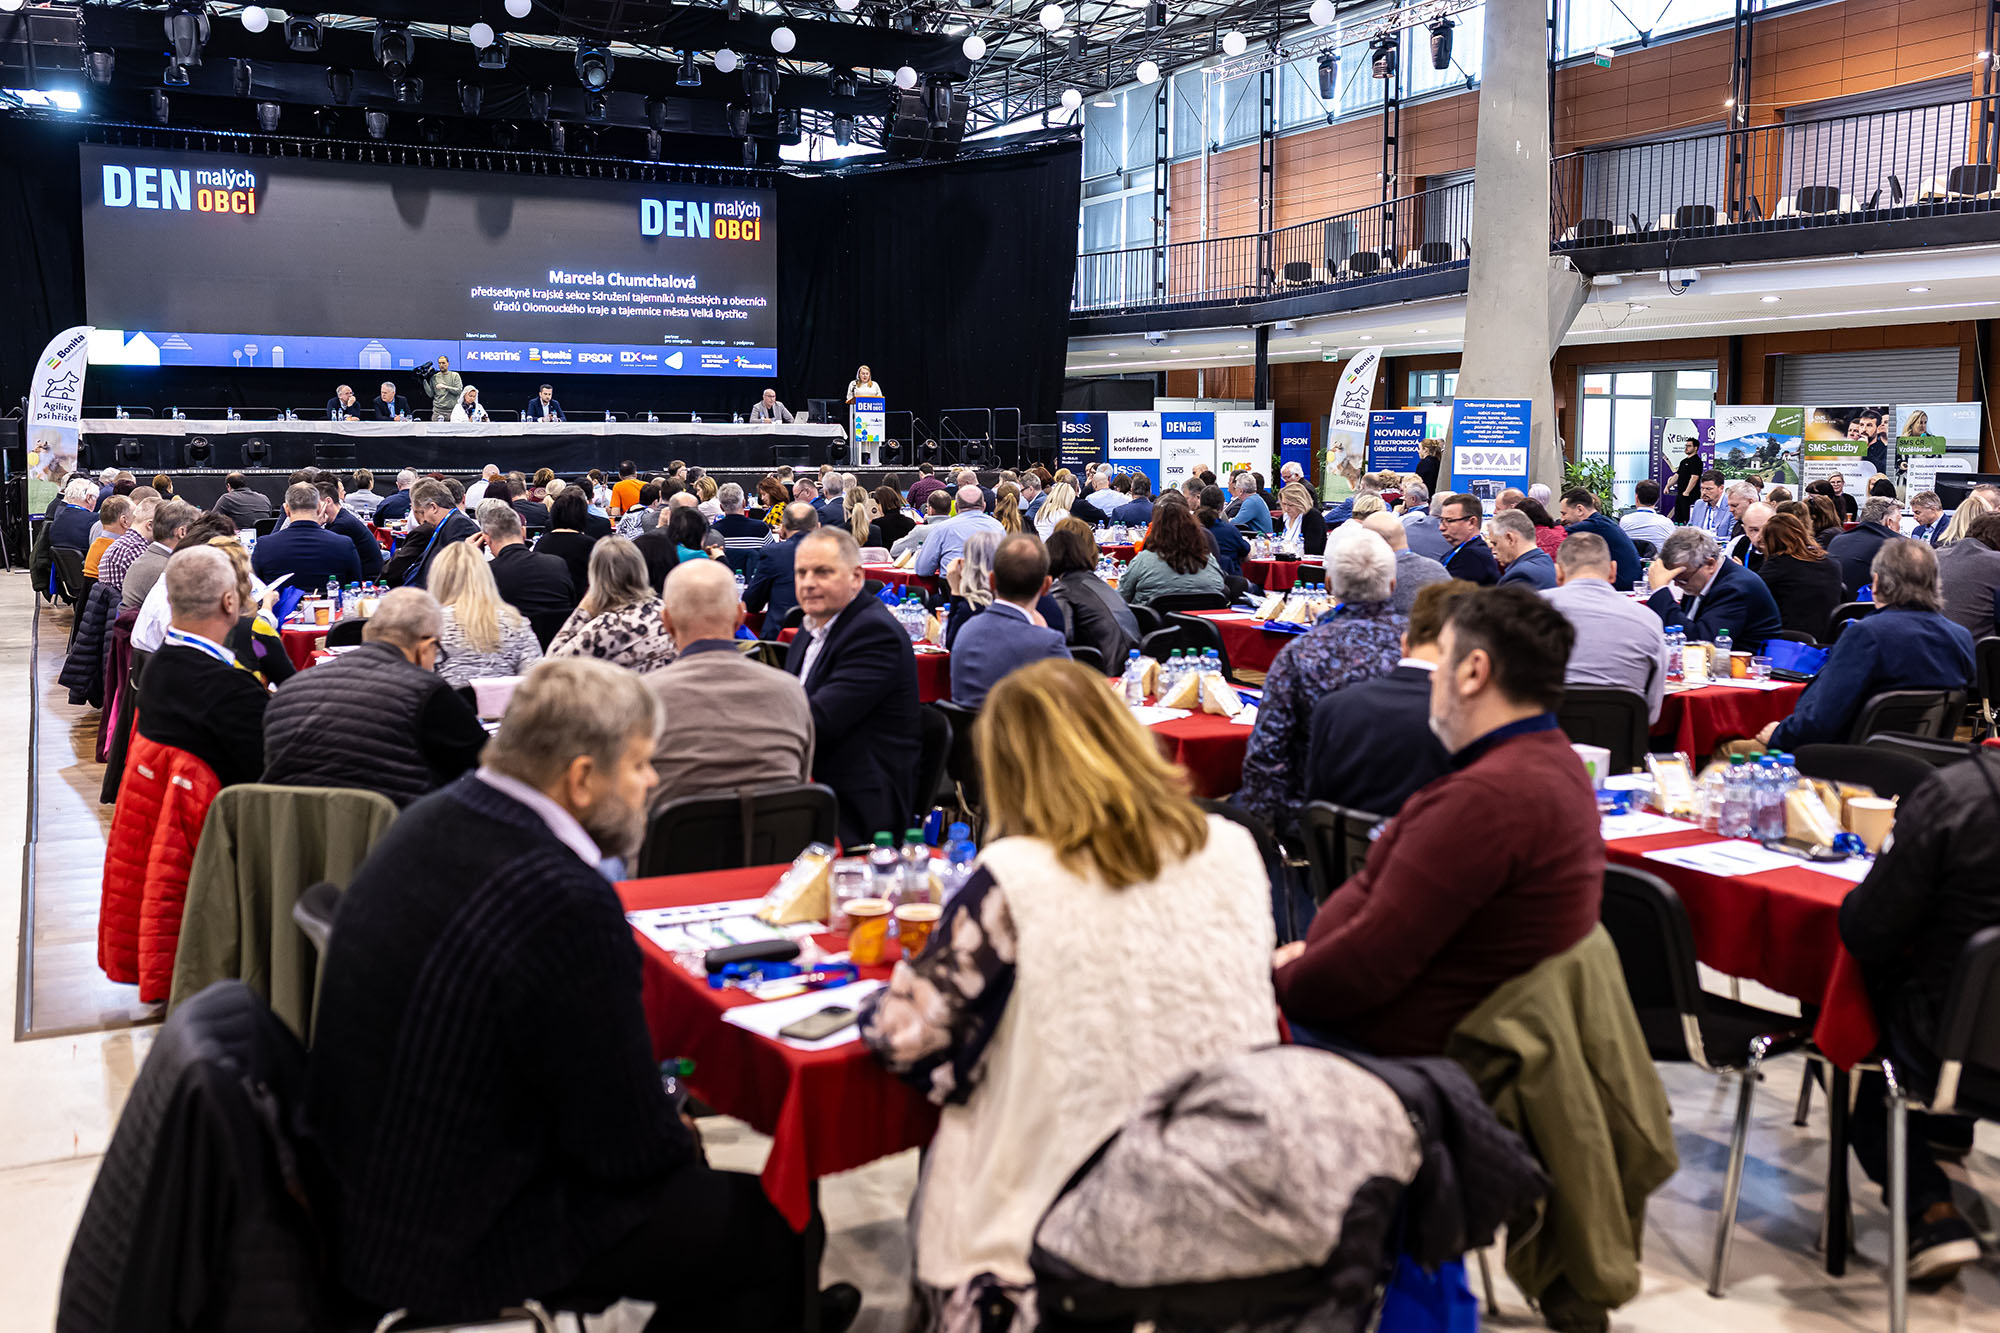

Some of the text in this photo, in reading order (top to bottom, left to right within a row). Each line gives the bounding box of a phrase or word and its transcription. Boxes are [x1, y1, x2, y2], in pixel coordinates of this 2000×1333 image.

[102, 165, 191, 210] DEN
[196, 168, 256, 190] malých
[197, 188, 256, 214] OBCÍ
[714, 200, 760, 219] malých
[640, 198, 710, 239] DEN
[714, 218, 761, 241] OBCÍ
[549, 270, 696, 288] Marcela Chumchalová
[471, 286, 530, 299] předsedkyně
[532, 289, 563, 300] krajské
[566, 292, 590, 300] sekce
[593, 292, 630, 302] Sdružení
[632, 293, 675, 304] tajemníků
[677, 295, 720, 306] městských
[730, 296, 767, 306] obecních
[493, 301, 520, 311] úřadů
[522, 303, 585, 314] Olomouckého
[587, 305, 608, 316] kraje
[619, 306, 661, 317] tajemnice
[663, 308, 689, 317] města
[691, 308, 713, 318] Velká
[715, 309, 748, 320] Bystřice
[57, 334, 85, 359] Bonita
[467, 352, 478, 360] AC
[578, 353, 611, 363] EPSON
[1354, 354, 1375, 374] Bonita
[43, 402, 73, 413] Agility
[1341, 410, 1363, 420] Agility
[37, 412, 78, 423] psí hřiště
[1166, 422, 1186, 432] DEN
[1461, 452, 1521, 465] SOVAK
